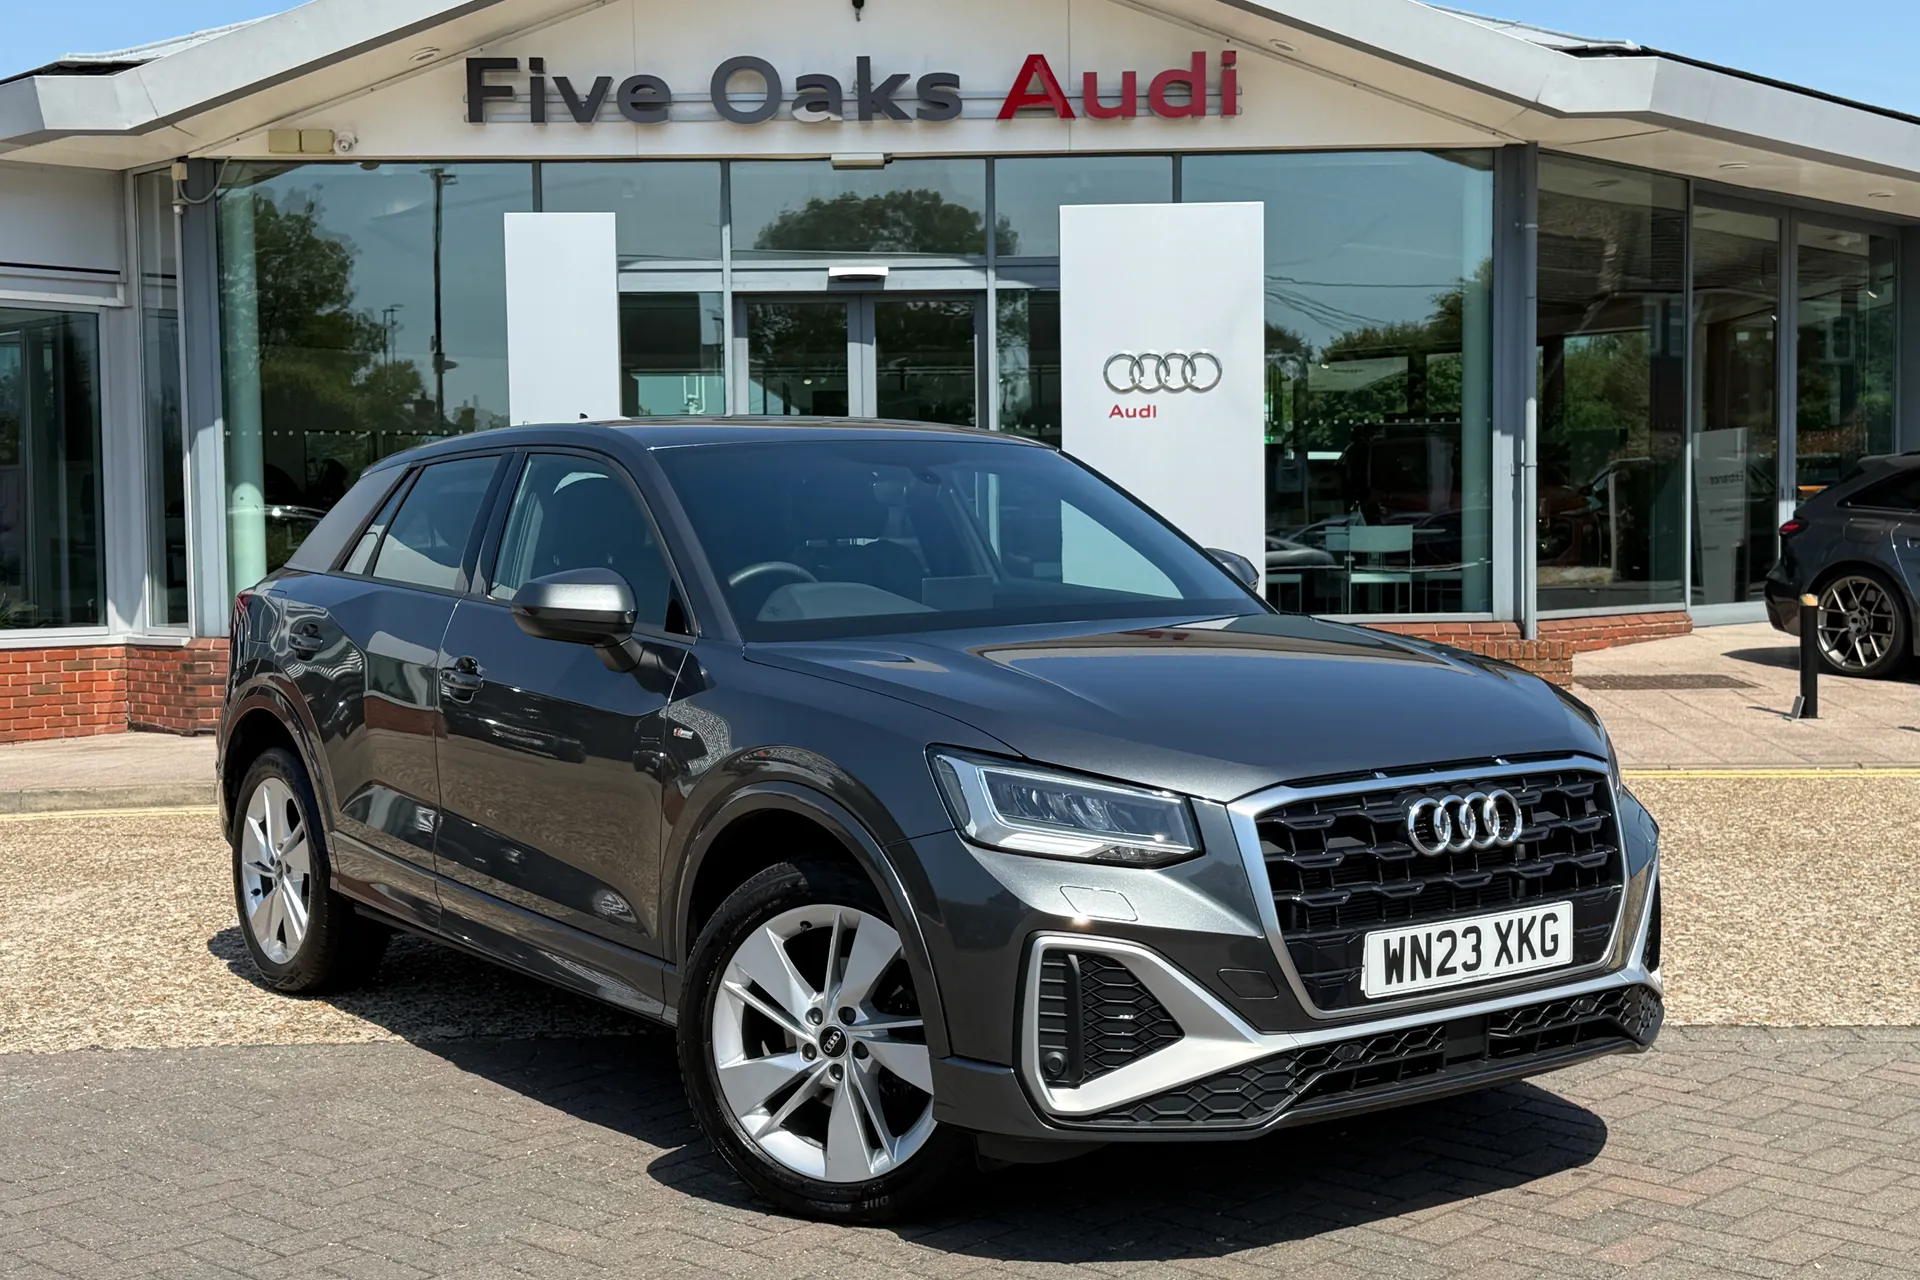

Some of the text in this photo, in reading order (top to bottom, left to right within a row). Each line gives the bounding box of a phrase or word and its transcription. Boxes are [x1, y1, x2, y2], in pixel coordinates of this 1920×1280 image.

[466, 50, 1237, 125] Five Oaks Audi
[1108, 404, 1157, 419] Audi
[1383, 912, 1559, 986] WN23 XKG
